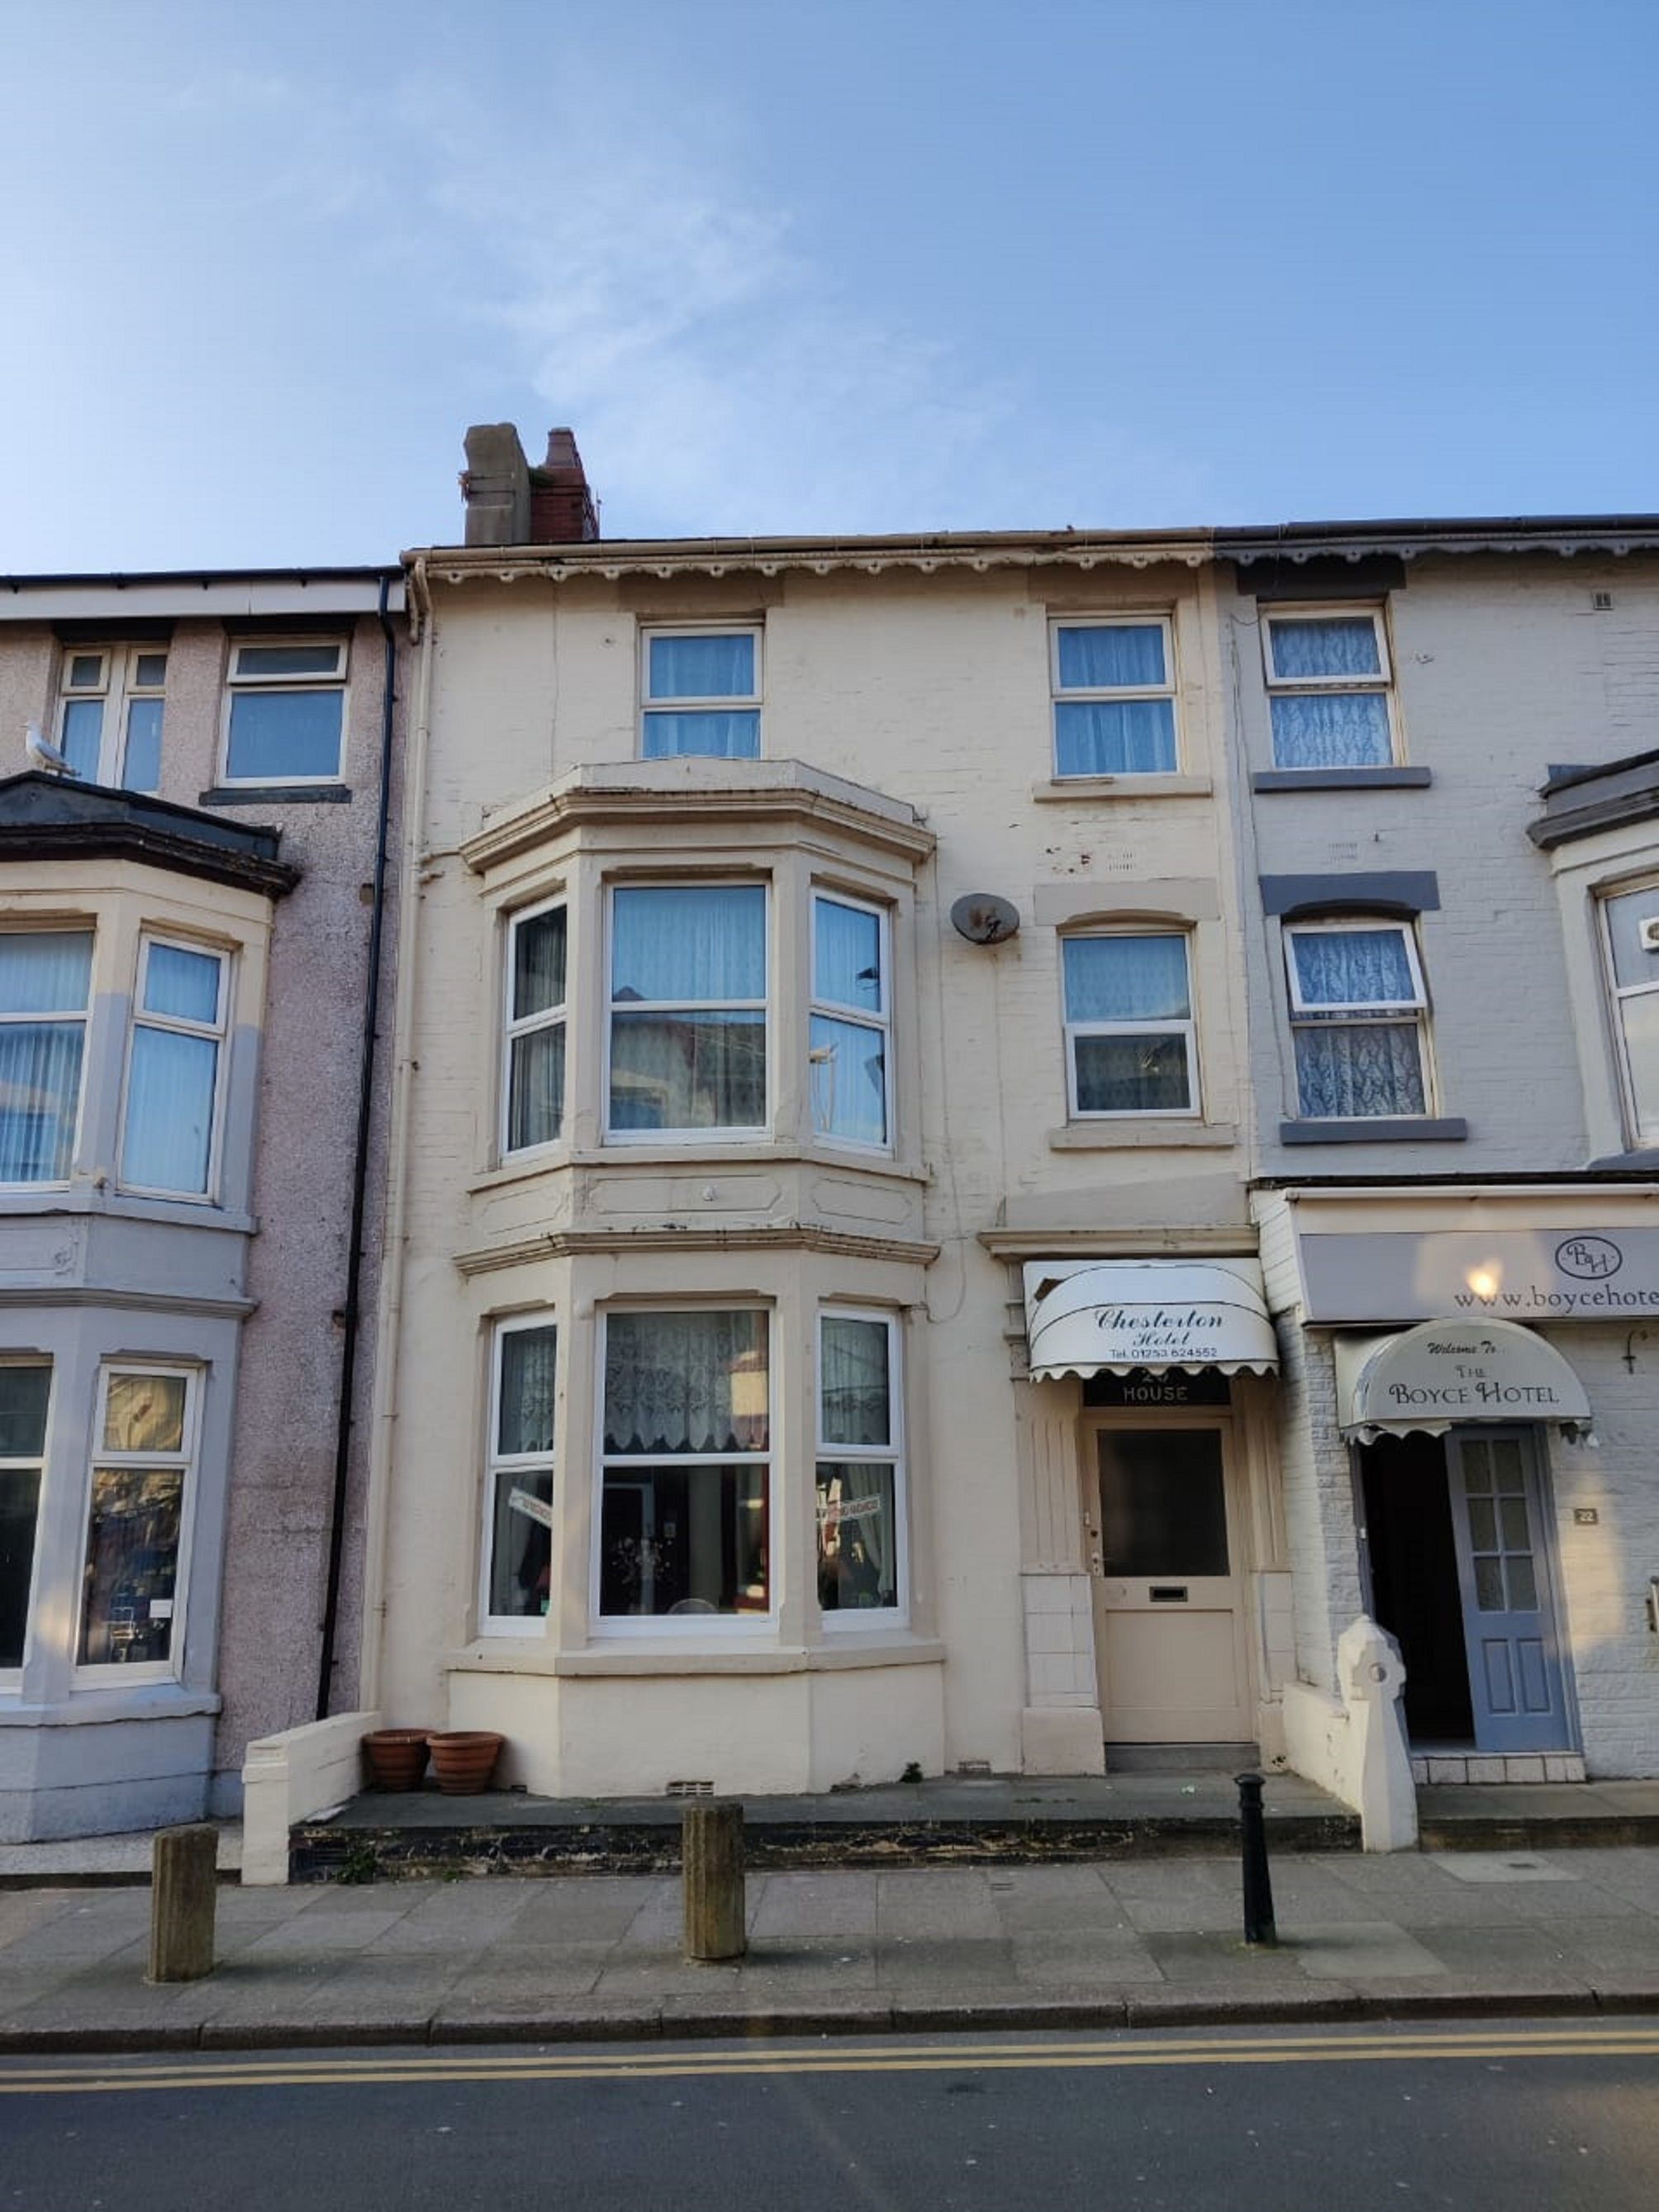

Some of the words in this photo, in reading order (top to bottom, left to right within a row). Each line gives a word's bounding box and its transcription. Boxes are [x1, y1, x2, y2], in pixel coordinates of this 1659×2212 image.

[1095, 1310, 1222, 1330] Chesterton
[1133, 1332, 1190, 1346] Hotel
[1427, 1342, 1476, 1354] Welcome
[1124, 1387, 1188, 1401] HOUSE
[1389, 1383, 1469, 1404] BOYCE
[1475, 1382, 1560, 1403] HOTEL
